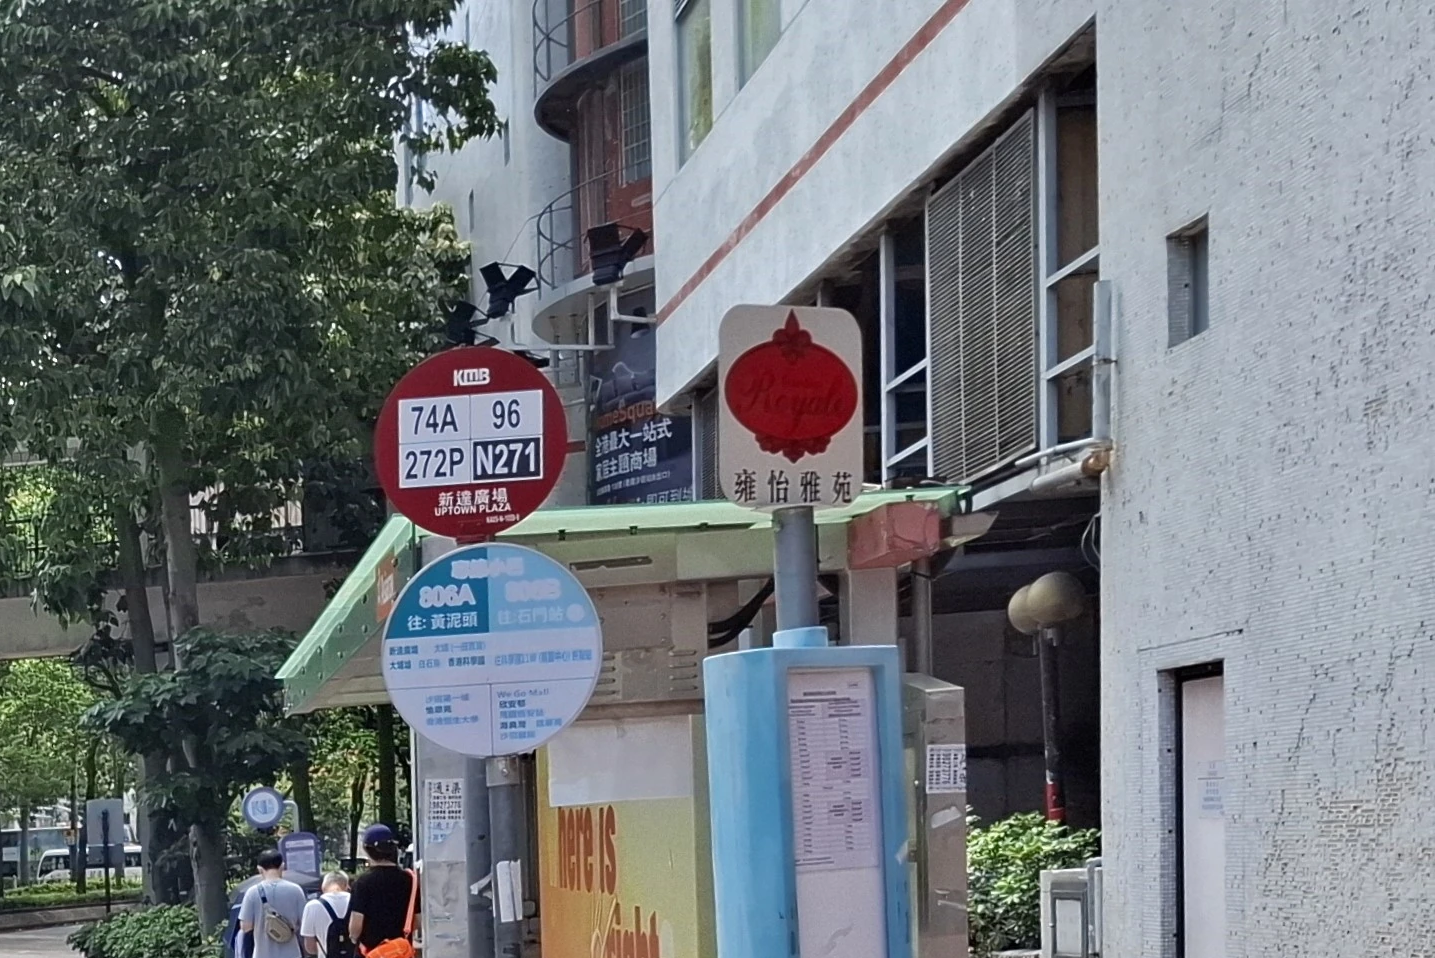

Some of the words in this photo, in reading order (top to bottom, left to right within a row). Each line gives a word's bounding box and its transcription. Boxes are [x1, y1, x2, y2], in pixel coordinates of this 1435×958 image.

[453, 368, 490, 387] KMB
[411, 403, 458, 434] 74A
[492, 399, 521, 430] 96
[595, 418, 672, 458] 全港最大一站式
[405, 447, 464, 480] 272P
[476, 442, 536, 476] N271
[438, 488, 508, 506] 新達廣場
[734, 468, 853, 504] 雍怡雅苑
[434, 504, 477, 516] UPTOWN
[479, 502, 512, 513] PLAZA
[419, 583, 476, 608] 806A
